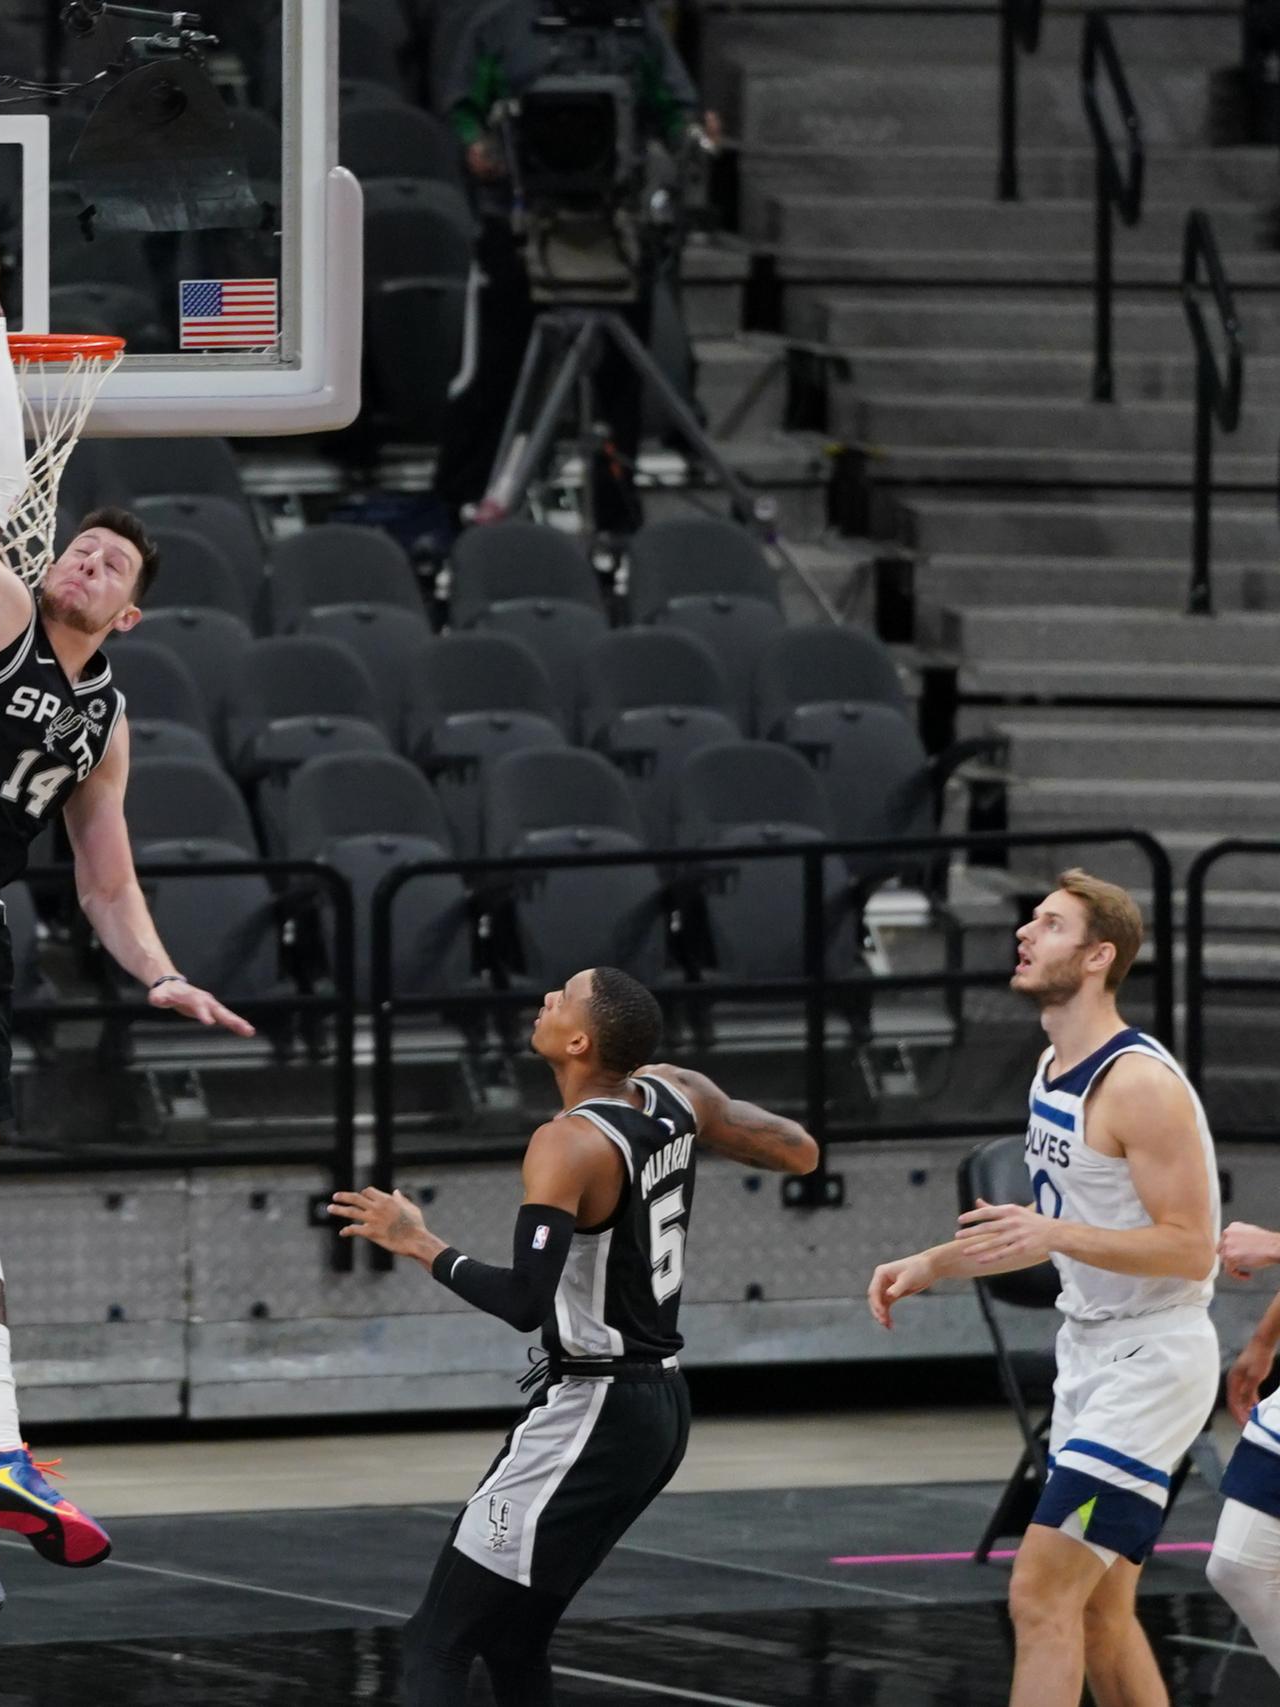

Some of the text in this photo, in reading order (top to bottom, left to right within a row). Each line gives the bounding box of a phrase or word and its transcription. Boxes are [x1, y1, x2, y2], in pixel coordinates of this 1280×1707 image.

[0, 749, 76, 819] 14
[641, 1132, 695, 1201] MURRAY
[649, 1184, 686, 1307] 5
